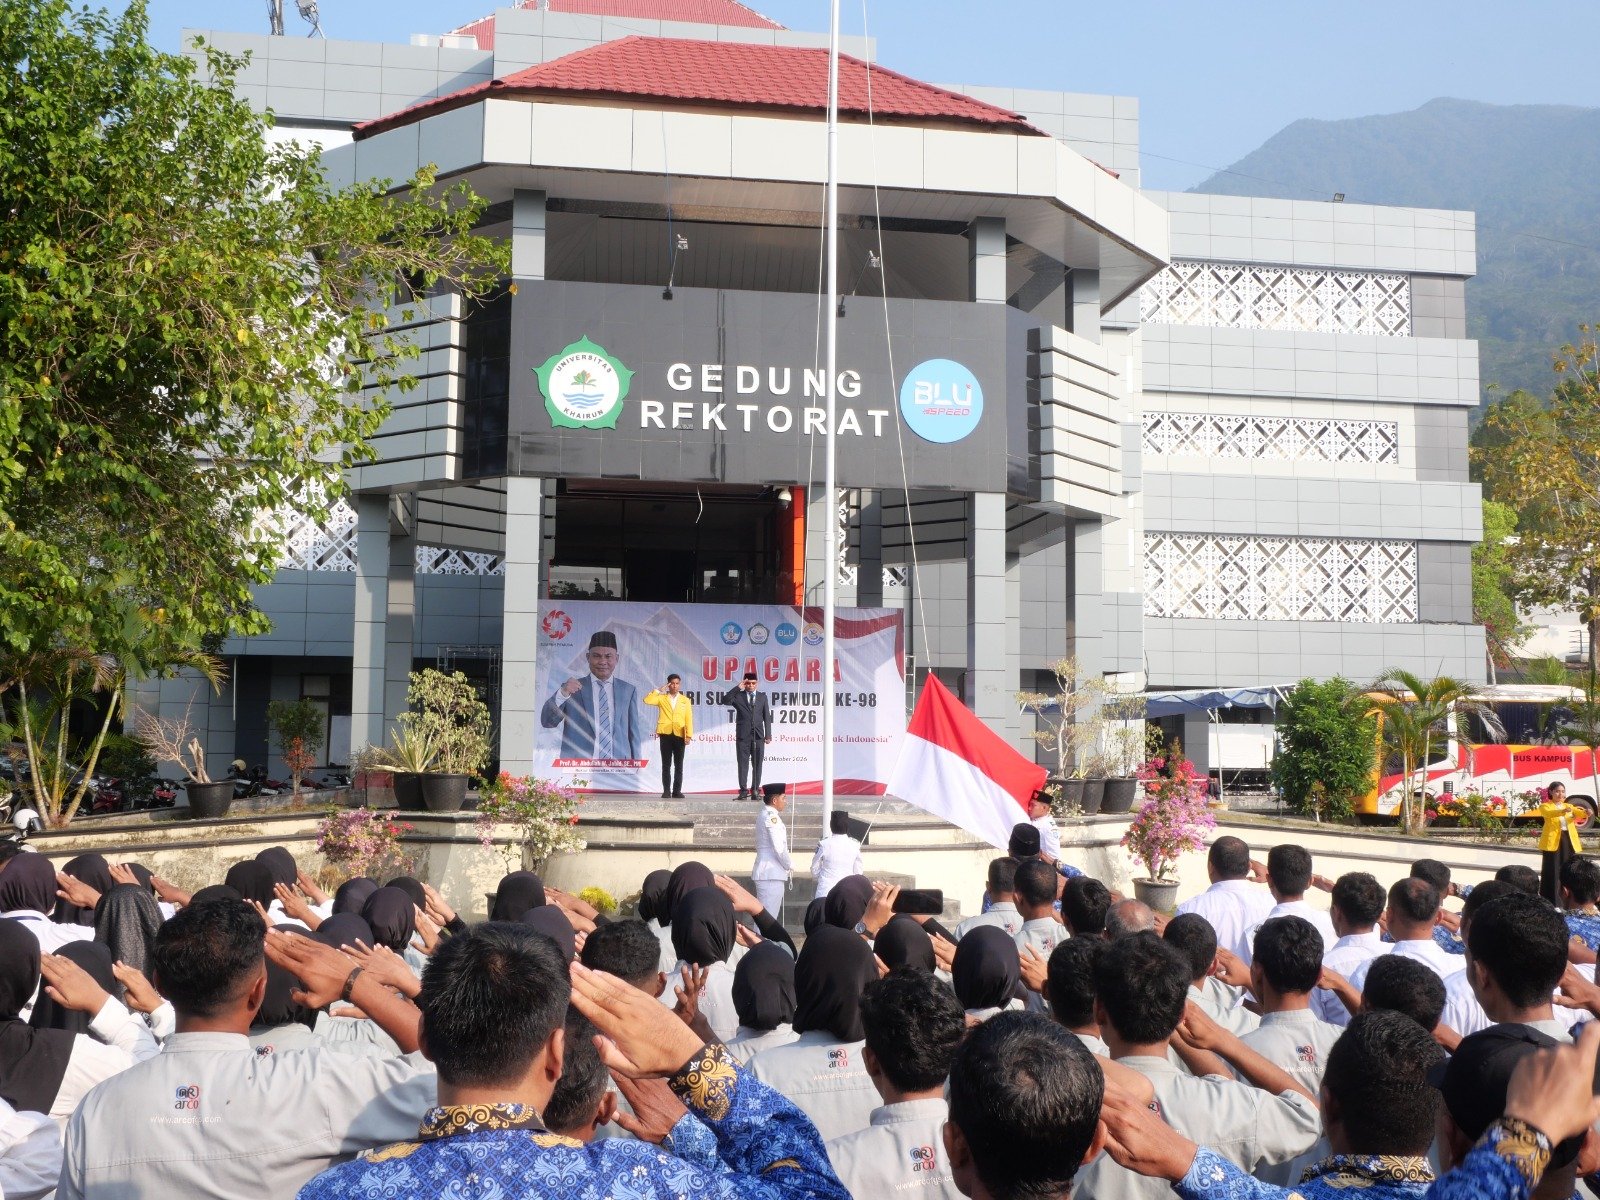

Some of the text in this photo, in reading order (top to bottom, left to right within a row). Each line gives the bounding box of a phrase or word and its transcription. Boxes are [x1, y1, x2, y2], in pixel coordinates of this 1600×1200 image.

[556, 354, 612, 373] UNIVERSITAS
[666, 363, 861, 398] GEDUNG
[914, 381, 972, 406] BLU
[563, 407, 604, 419] KHAIRUN
[640, 400, 889, 437] REKTORAT
[778, 629, 795, 637] BLU
[702, 656, 842, 683] UPACARA
[771, 691, 825, 706] PEMUD
[835, 692, 877, 707] KE-98
[779, 709, 817, 724] 2026
[780, 734, 815, 743] Pemuda
[817, 734, 844, 743] Uuk
[1534, 755, 1573, 763] KAMPUS
[828, 1060, 848, 1069] arco
[174, 1100, 199, 1110] arco
[912, 1160, 935, 1172] arco
[895, 1175, 954, 1191] www.arcofgs.co
